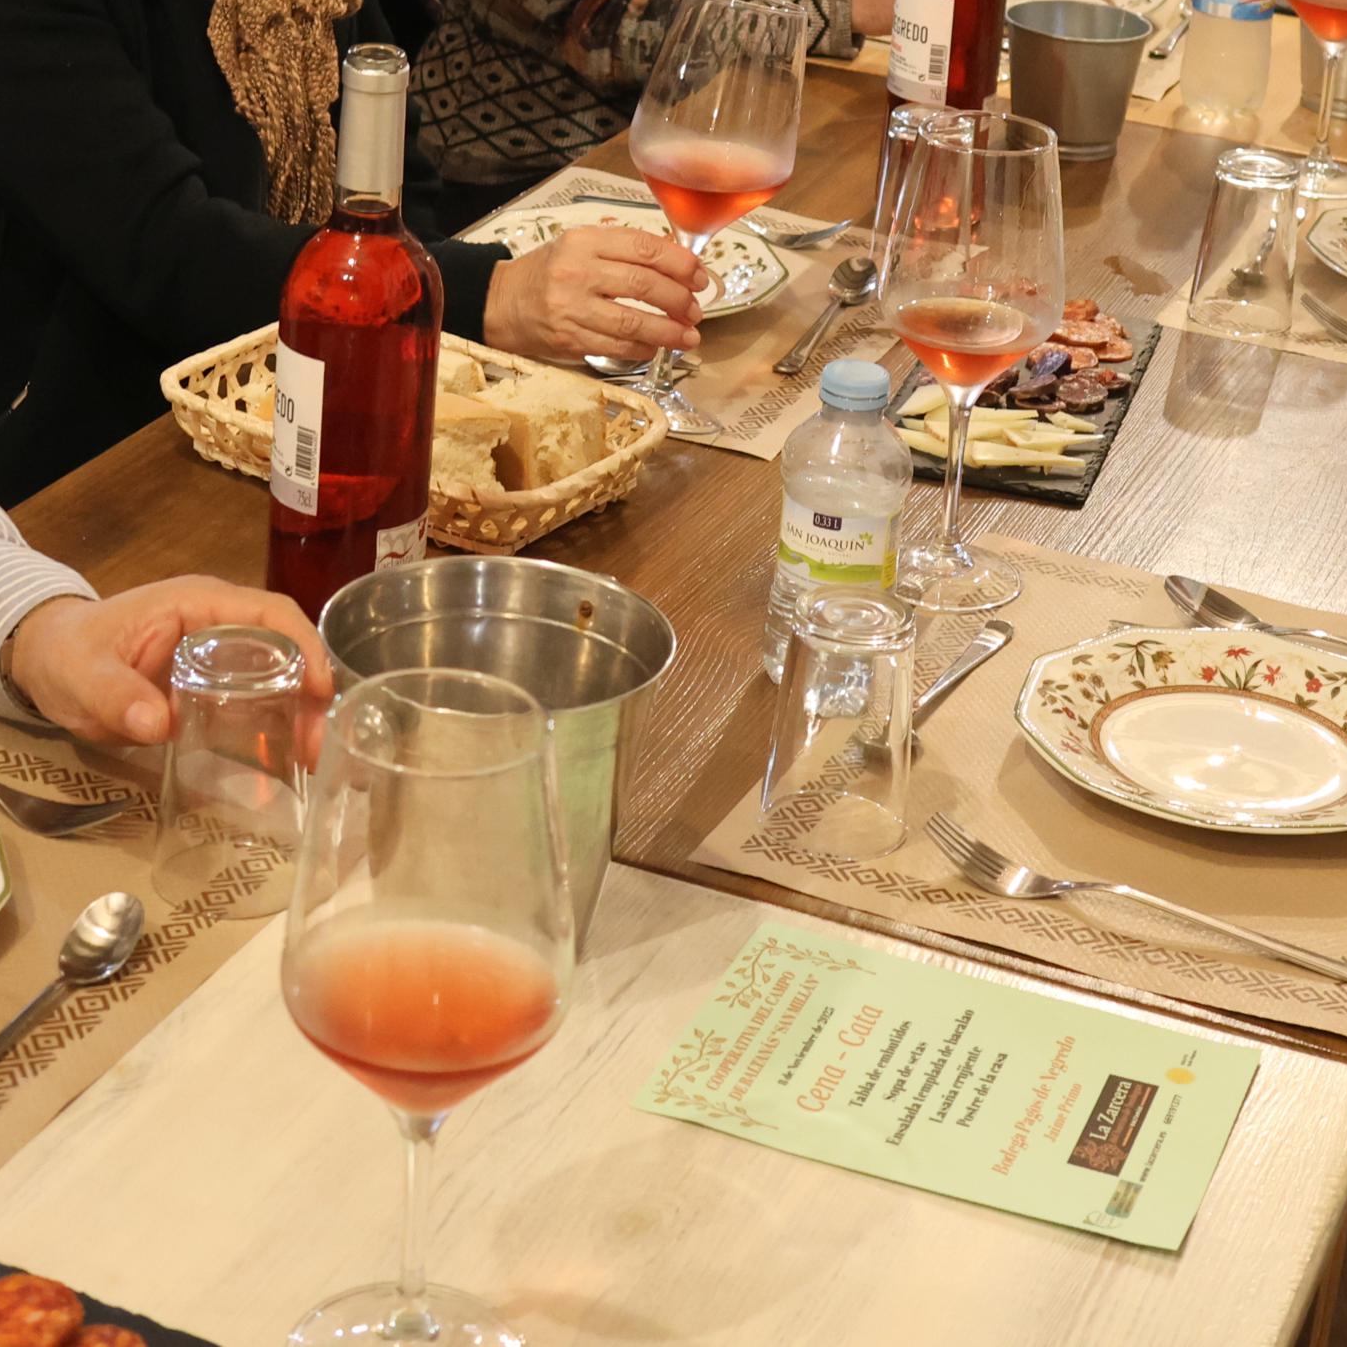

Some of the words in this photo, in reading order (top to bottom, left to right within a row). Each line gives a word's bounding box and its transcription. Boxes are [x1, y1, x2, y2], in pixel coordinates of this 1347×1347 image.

[786, 521, 803, 540] SAN
[805, 533, 865, 552] JOAQUÍN
[706, 1025, 760, 1091] COOPERATIVA
[750, 1005, 774, 1026] DEL
[764, 971, 795, 1006] CAMPO
[811, 1024, 823, 1034] de
[943, 1009, 974, 1046] bacalao
[787, 1034, 817, 1069] Noviembre
[796, 1064, 846, 1113] Cena
[838, 1005, 883, 1047] Cata
[848, 1081, 876, 1107] Tabla
[865, 1068, 882, 1082] de
[877, 1021, 911, 1069] embutidos
[937, 1045, 954, 1058] de
[990, 1052, 1008, 1074] casa
[1039, 1035, 1076, 1080] Negredo
[782, 1070, 794, 1081] de
[884, 1078, 907, 1102] Sopa
[896, 1065, 913, 1078] de
[908, 1041, 927, 1065] setas
[912, 1058, 948, 1102] templada
[928, 1089, 959, 1124] Lasaña
[952, 1046, 982, 1089] crujiente
[979, 1074, 997, 1084] la
[728, 1085, 748, 1102] DE
[973, 1083, 990, 1097] de
[1032, 1083, 1051, 1100] de
[1097, 1081, 1132, 1125] Zarcera
[885, 1103, 922, 1146] Ensalada
[955, 1096, 984, 1128] Postre
[1014, 1100, 1044, 1133] Pagos
[1043, 1112, 1067, 1143] Jaime
[1057, 1083, 1082, 1114] Primo
[1089, 1125, 1112, 1141] La
[991, 1133, 1028, 1176] Bodega
